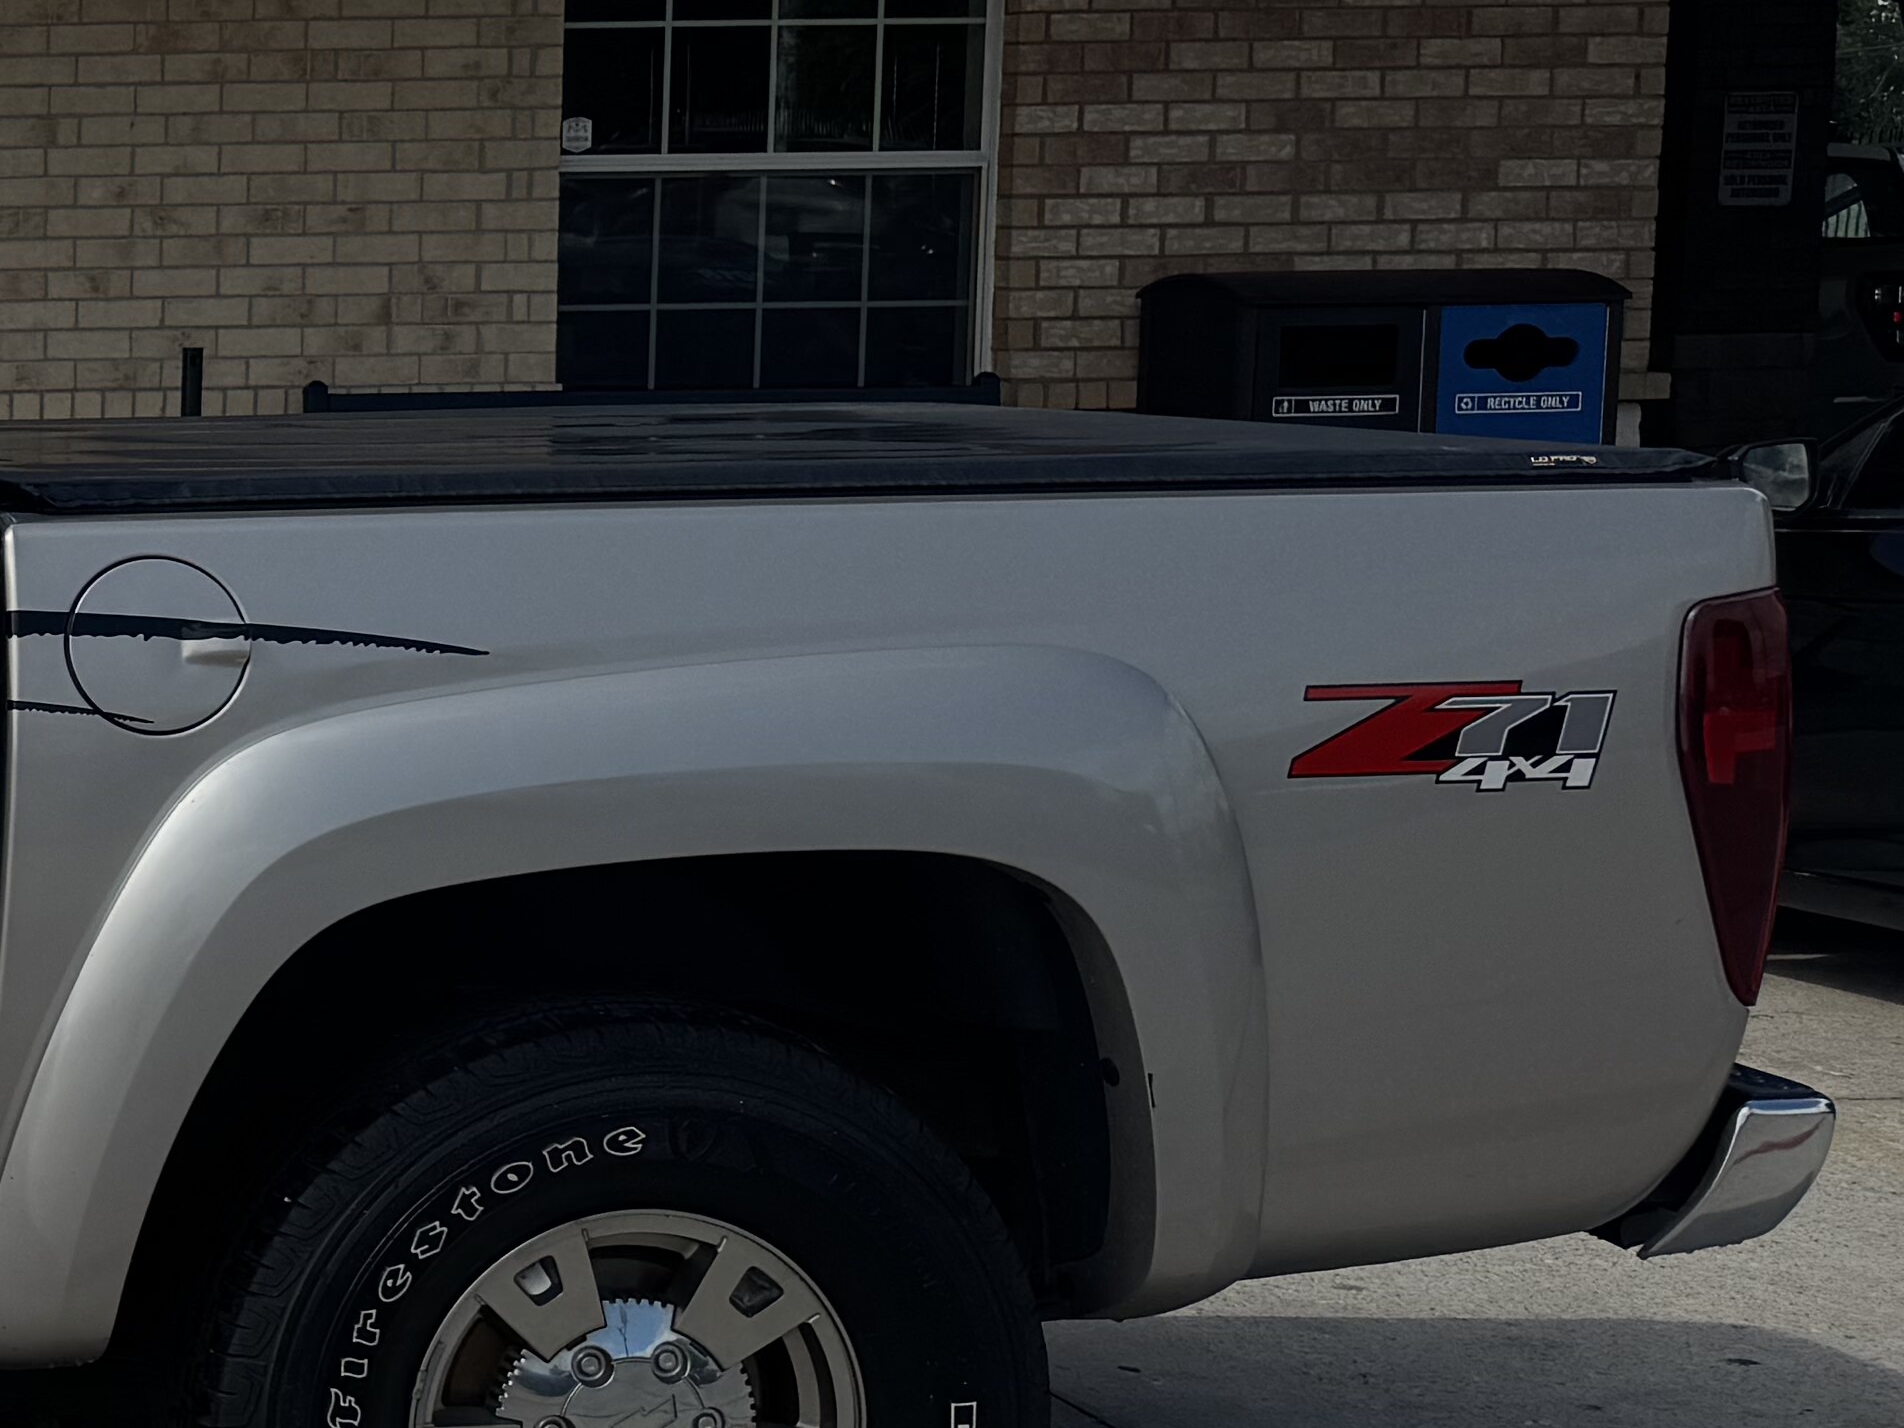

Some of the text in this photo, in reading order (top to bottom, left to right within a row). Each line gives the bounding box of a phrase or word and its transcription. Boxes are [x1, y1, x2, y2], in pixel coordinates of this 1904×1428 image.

[1308, 398, 1382, 412] WASTE ONLY
[1487, 395, 1571, 409] RECYCLE ONLY
[1287, 680, 1617, 779] Z71
